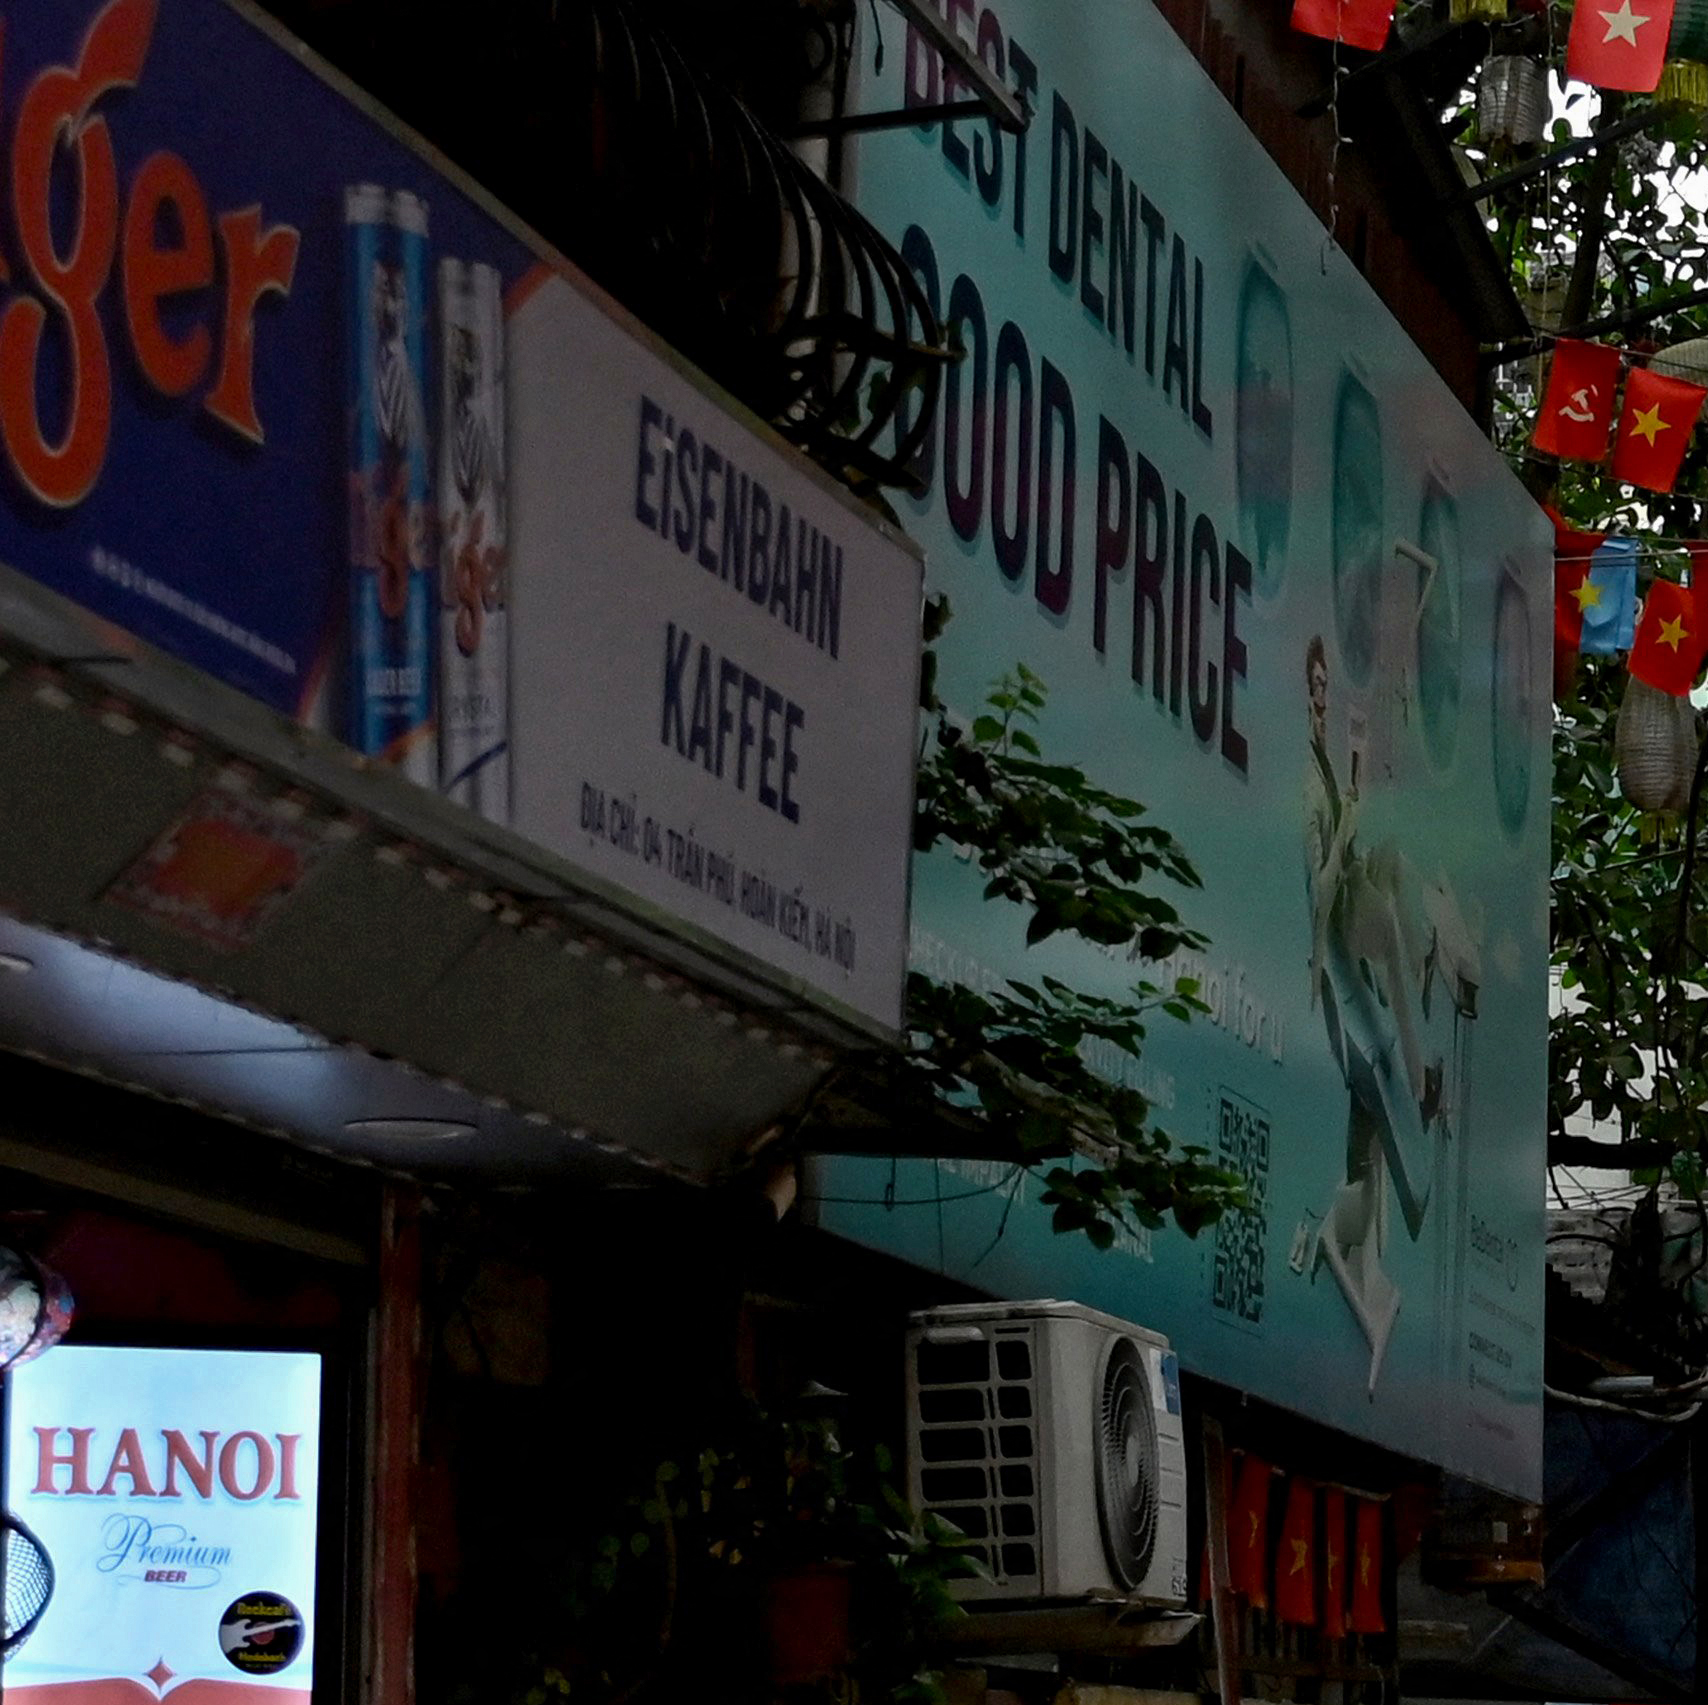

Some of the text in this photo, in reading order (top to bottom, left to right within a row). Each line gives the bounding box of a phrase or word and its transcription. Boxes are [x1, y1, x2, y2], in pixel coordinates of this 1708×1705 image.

[0, 0, 301, 507] ger
[1049, 88, 1213, 438] DENTAL
[635, 394, 845, 660] EISENBAHN
[1094, 412, 1252, 781] PRICE
[661, 621, 805, 824] KAFFEE
[30, 1426, 302, 1499] HANOI
[96, 1513, 233, 1573] Premium
[144, 1568, 188, 1583] BEER
